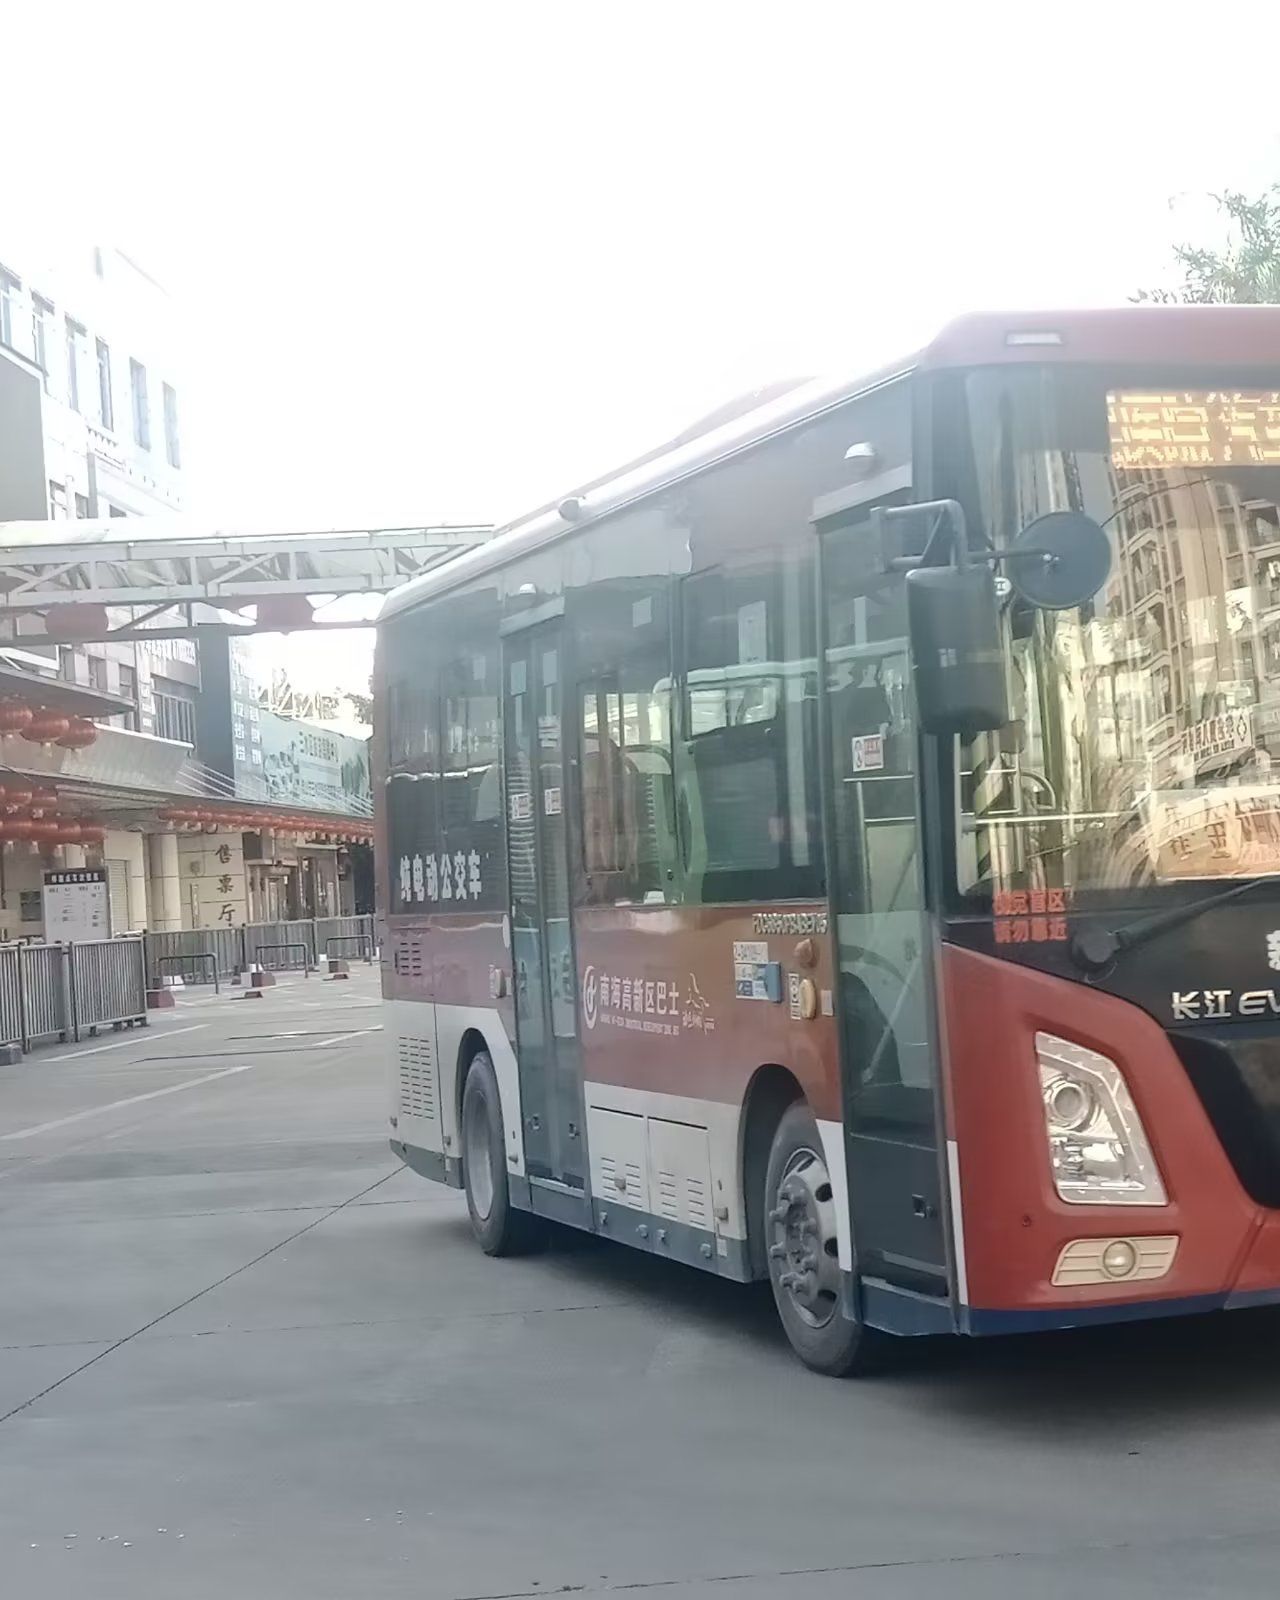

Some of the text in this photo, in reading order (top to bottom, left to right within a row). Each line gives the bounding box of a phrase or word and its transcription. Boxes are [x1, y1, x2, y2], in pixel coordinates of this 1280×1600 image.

[215, 843, 236, 921] 售票厅
[400, 848, 482, 902] 纯电动公交车
[600, 971, 680, 1016] 南海高新区巴士
[1171, 990, 1233, 1020] 长江
